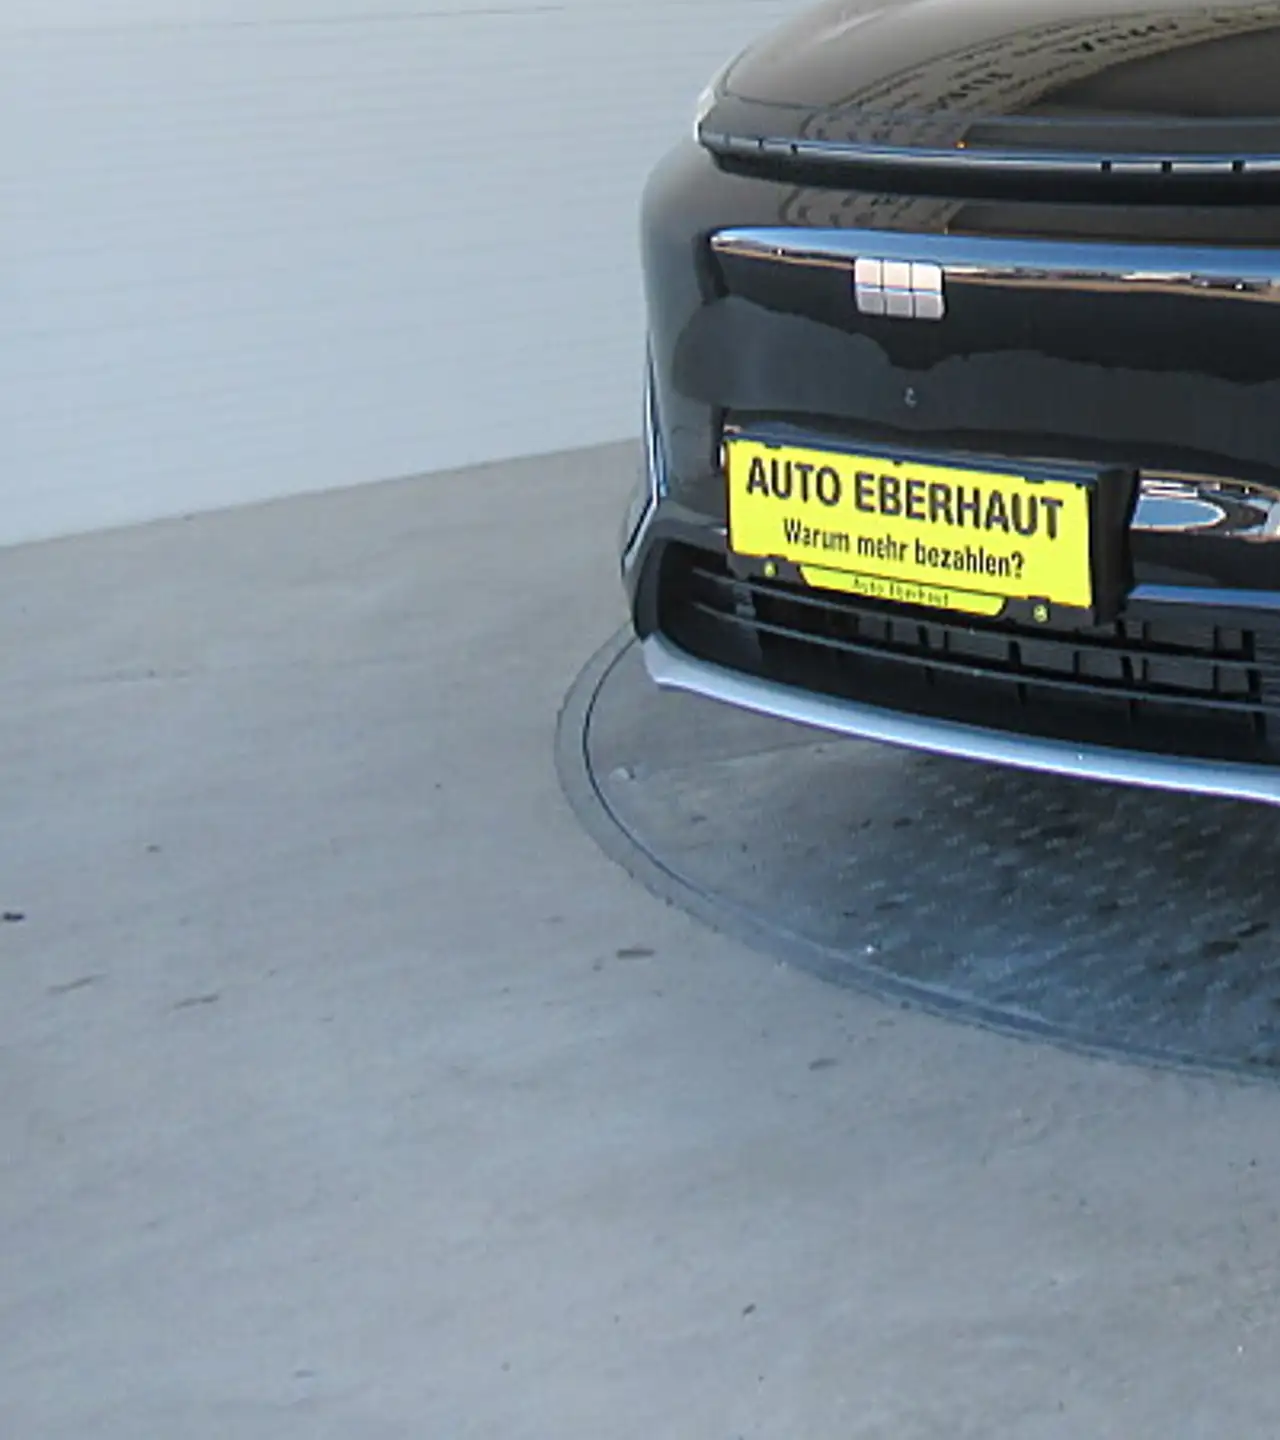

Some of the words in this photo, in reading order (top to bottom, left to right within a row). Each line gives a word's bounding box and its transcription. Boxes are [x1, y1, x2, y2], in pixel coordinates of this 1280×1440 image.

[746, 457, 841, 506] AUTO
[855, 472, 1063, 540] EBERHAUT
[784, 518, 849, 552] Warum
[858, 534, 908, 562] mehr
[915, 538, 1024, 578] bezahlen?
